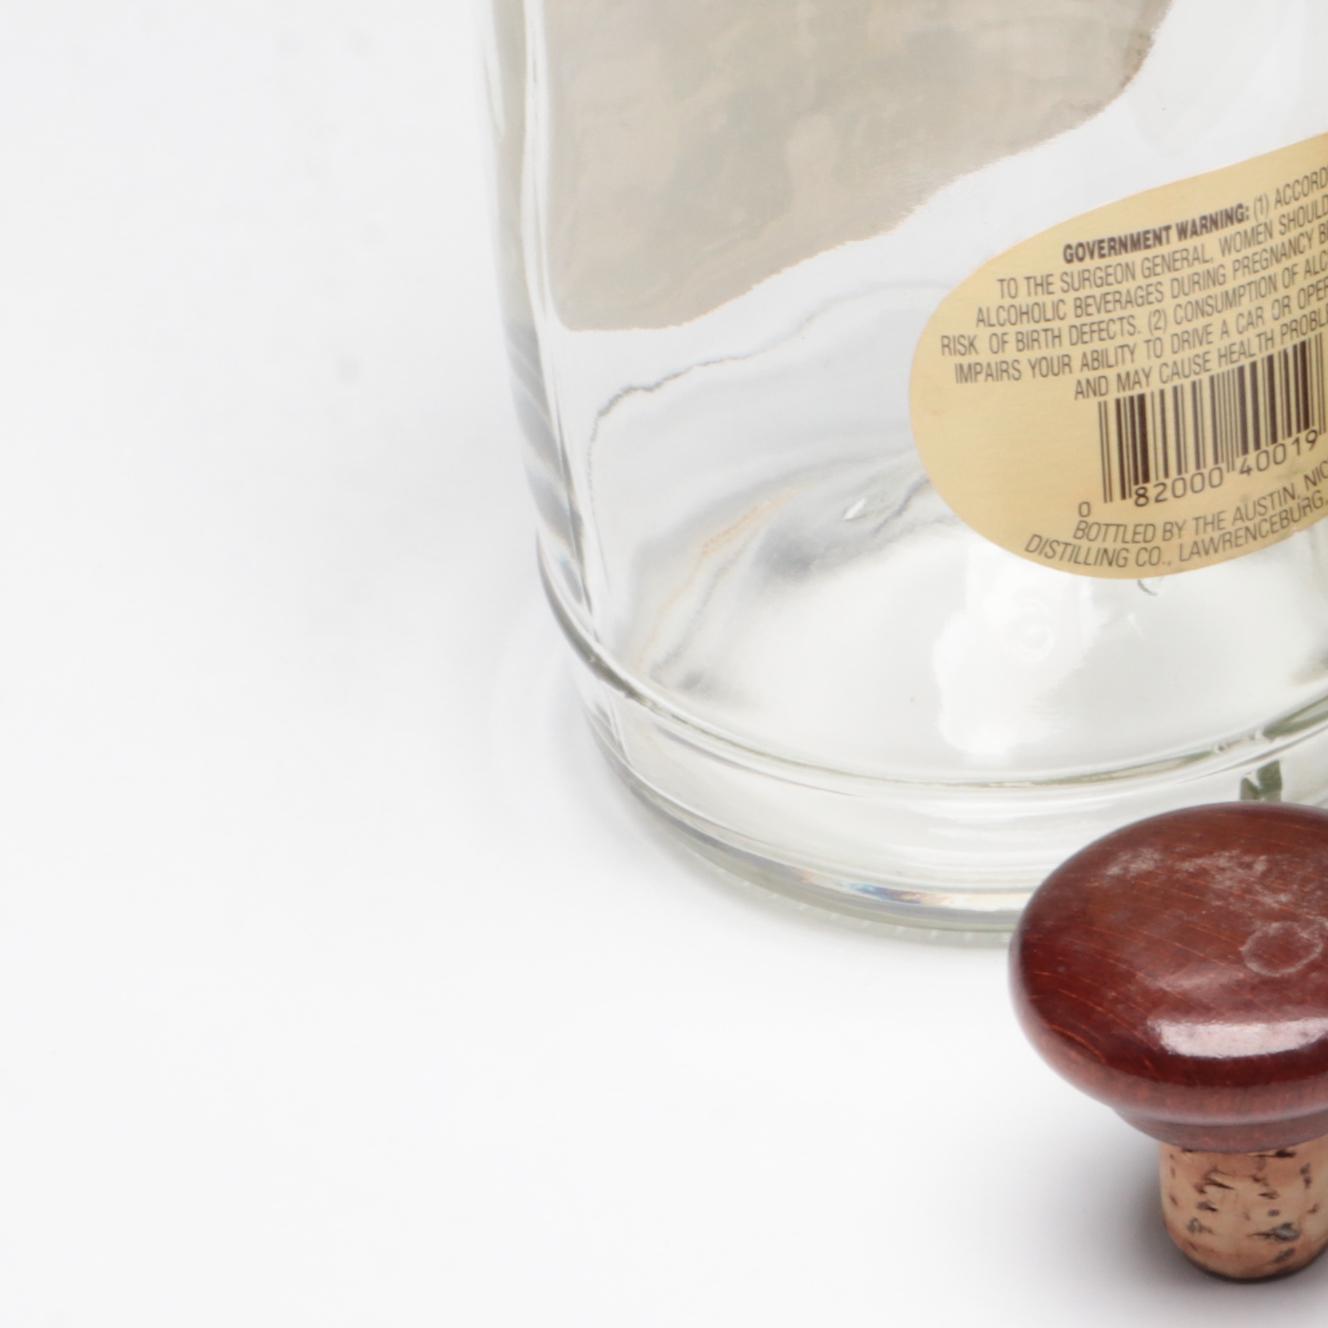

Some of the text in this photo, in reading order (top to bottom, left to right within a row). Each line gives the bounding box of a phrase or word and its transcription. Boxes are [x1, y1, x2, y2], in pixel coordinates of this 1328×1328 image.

[997, 277, 1018, 300] TO
[1024, 273, 1055, 297] THE
[1060, 260, 1136, 294] SURGEON
[1218, 221, 1274, 258] WOMEN
[1063, 225, 1173, 264] GOVERNMENT
[1176, 203, 1250, 241] WARNING:
[1253, 193, 1270, 222] (1)
[941, 334, 979, 357] RISK
[988, 332, 1010, 355] OF
[1015, 327, 1062, 353] BIRTH
[1069, 314, 1141, 347] DEFECTS.
[1147, 309, 1168, 337] (2)
[1173, 273, 1278, 325] CONSUMPTION
[1281, 262, 1299, 290] OF
[976, 298, 1067, 328] ALCOHOLIC
[1073, 281, 1165, 319] BEVERAGES
[1170, 264, 1227, 300] DURING
[1232, 228, 1315, 280] PREGNANCY
[954, 359, 1022, 384] IMPAIRS
[1027, 354, 1073, 379] YOUR
[1080, 343, 1137, 373] ABILITY
[1143, 336, 1164, 360] TO
[1170, 323, 1214, 355] DRIVE
[1220, 319, 1231, 341] A
[1235, 306, 1265, 335] CAR
[1271, 294, 1292, 322] OR
[1074, 375, 1110, 401] AND
[1116, 366, 1152, 394] MAY
[1158, 350, 1212, 385] CAUSE
[1217, 330, 1275, 366] HEALTH
[1077, 429, 1319, 518] 0 82000 40019
[1024, 533, 1130, 568] DISTILLING
[1073, 519, 1156, 544] BOTTLED
[1162, 519, 1186, 542] BY
[1192, 510, 1227, 535] THE
